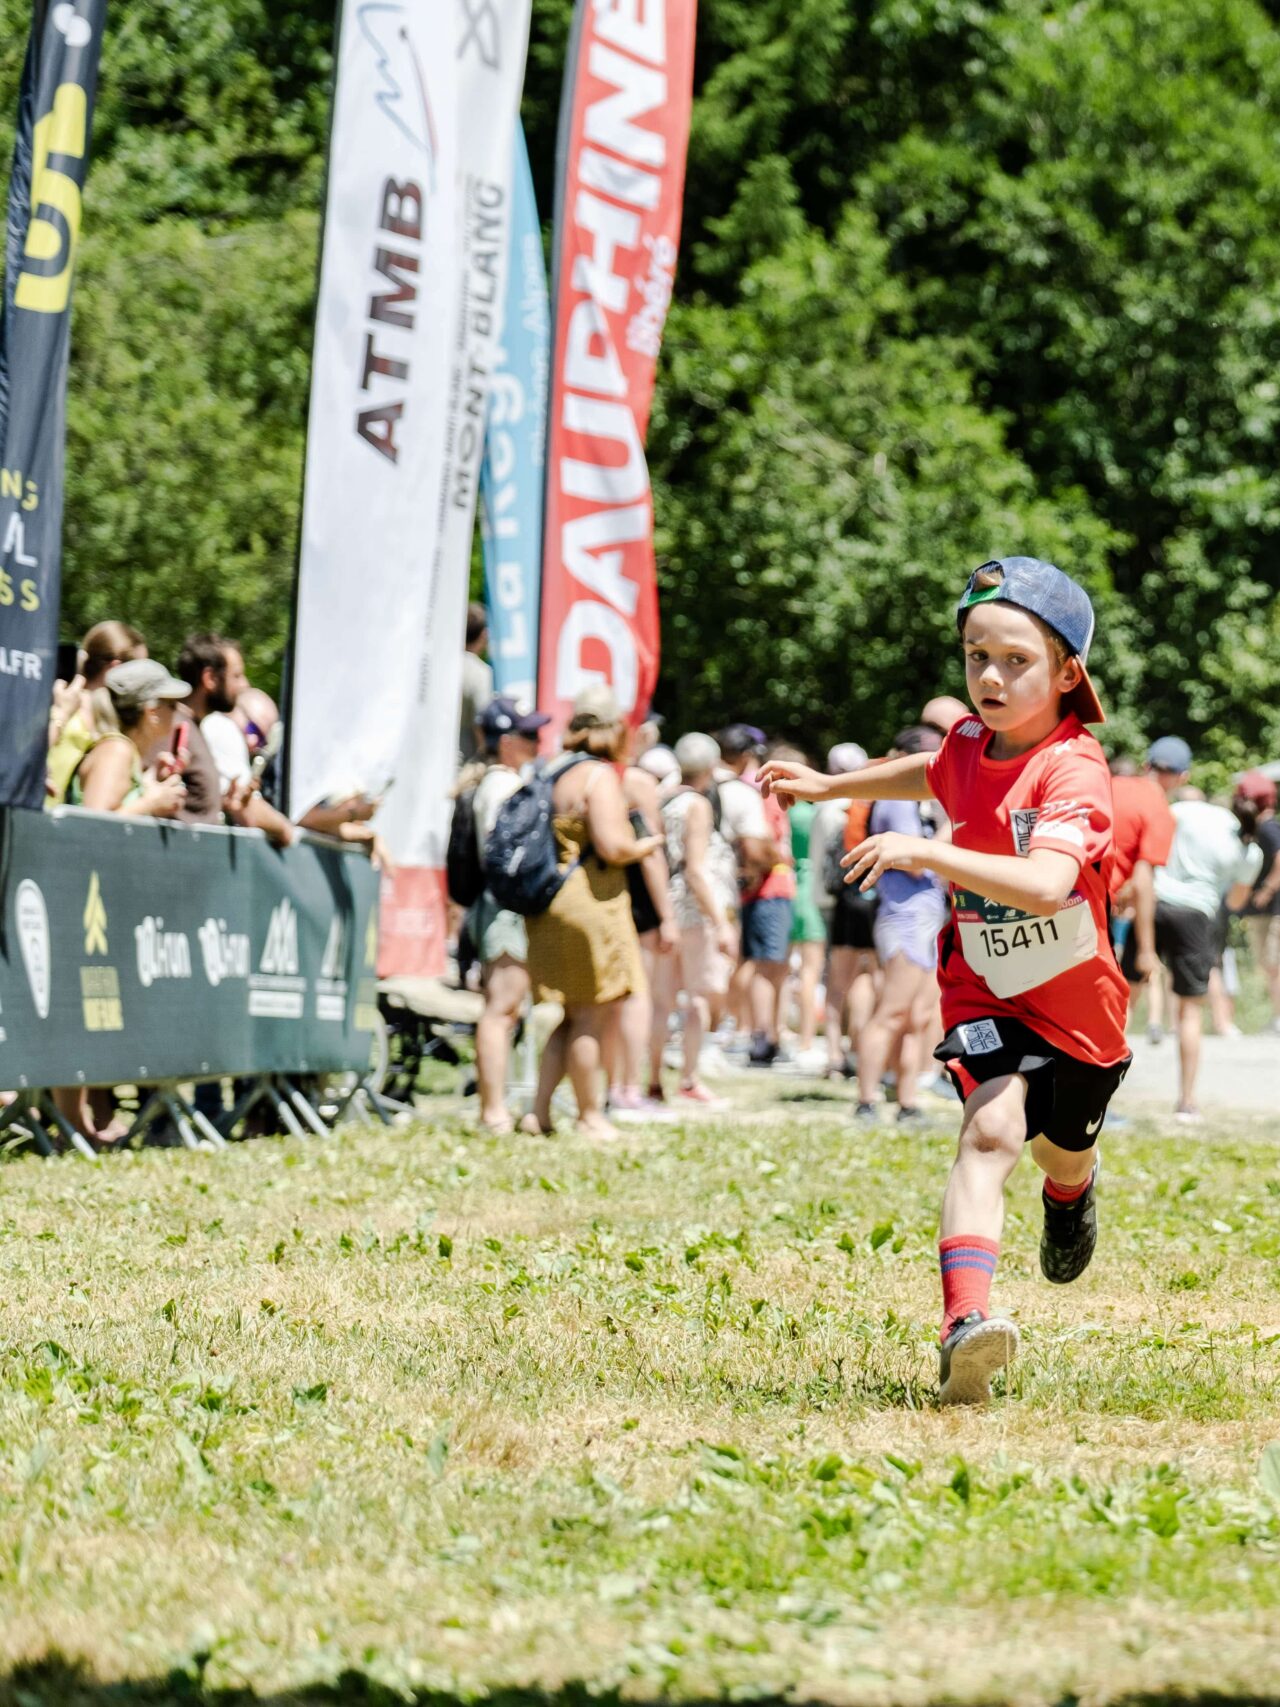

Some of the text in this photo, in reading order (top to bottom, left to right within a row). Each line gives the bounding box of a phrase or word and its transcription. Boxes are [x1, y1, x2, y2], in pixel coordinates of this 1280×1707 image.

[354, 176, 423, 465] ATMB
[956, 720, 985, 738] NIK
[979, 918, 1059, 958] 15411
